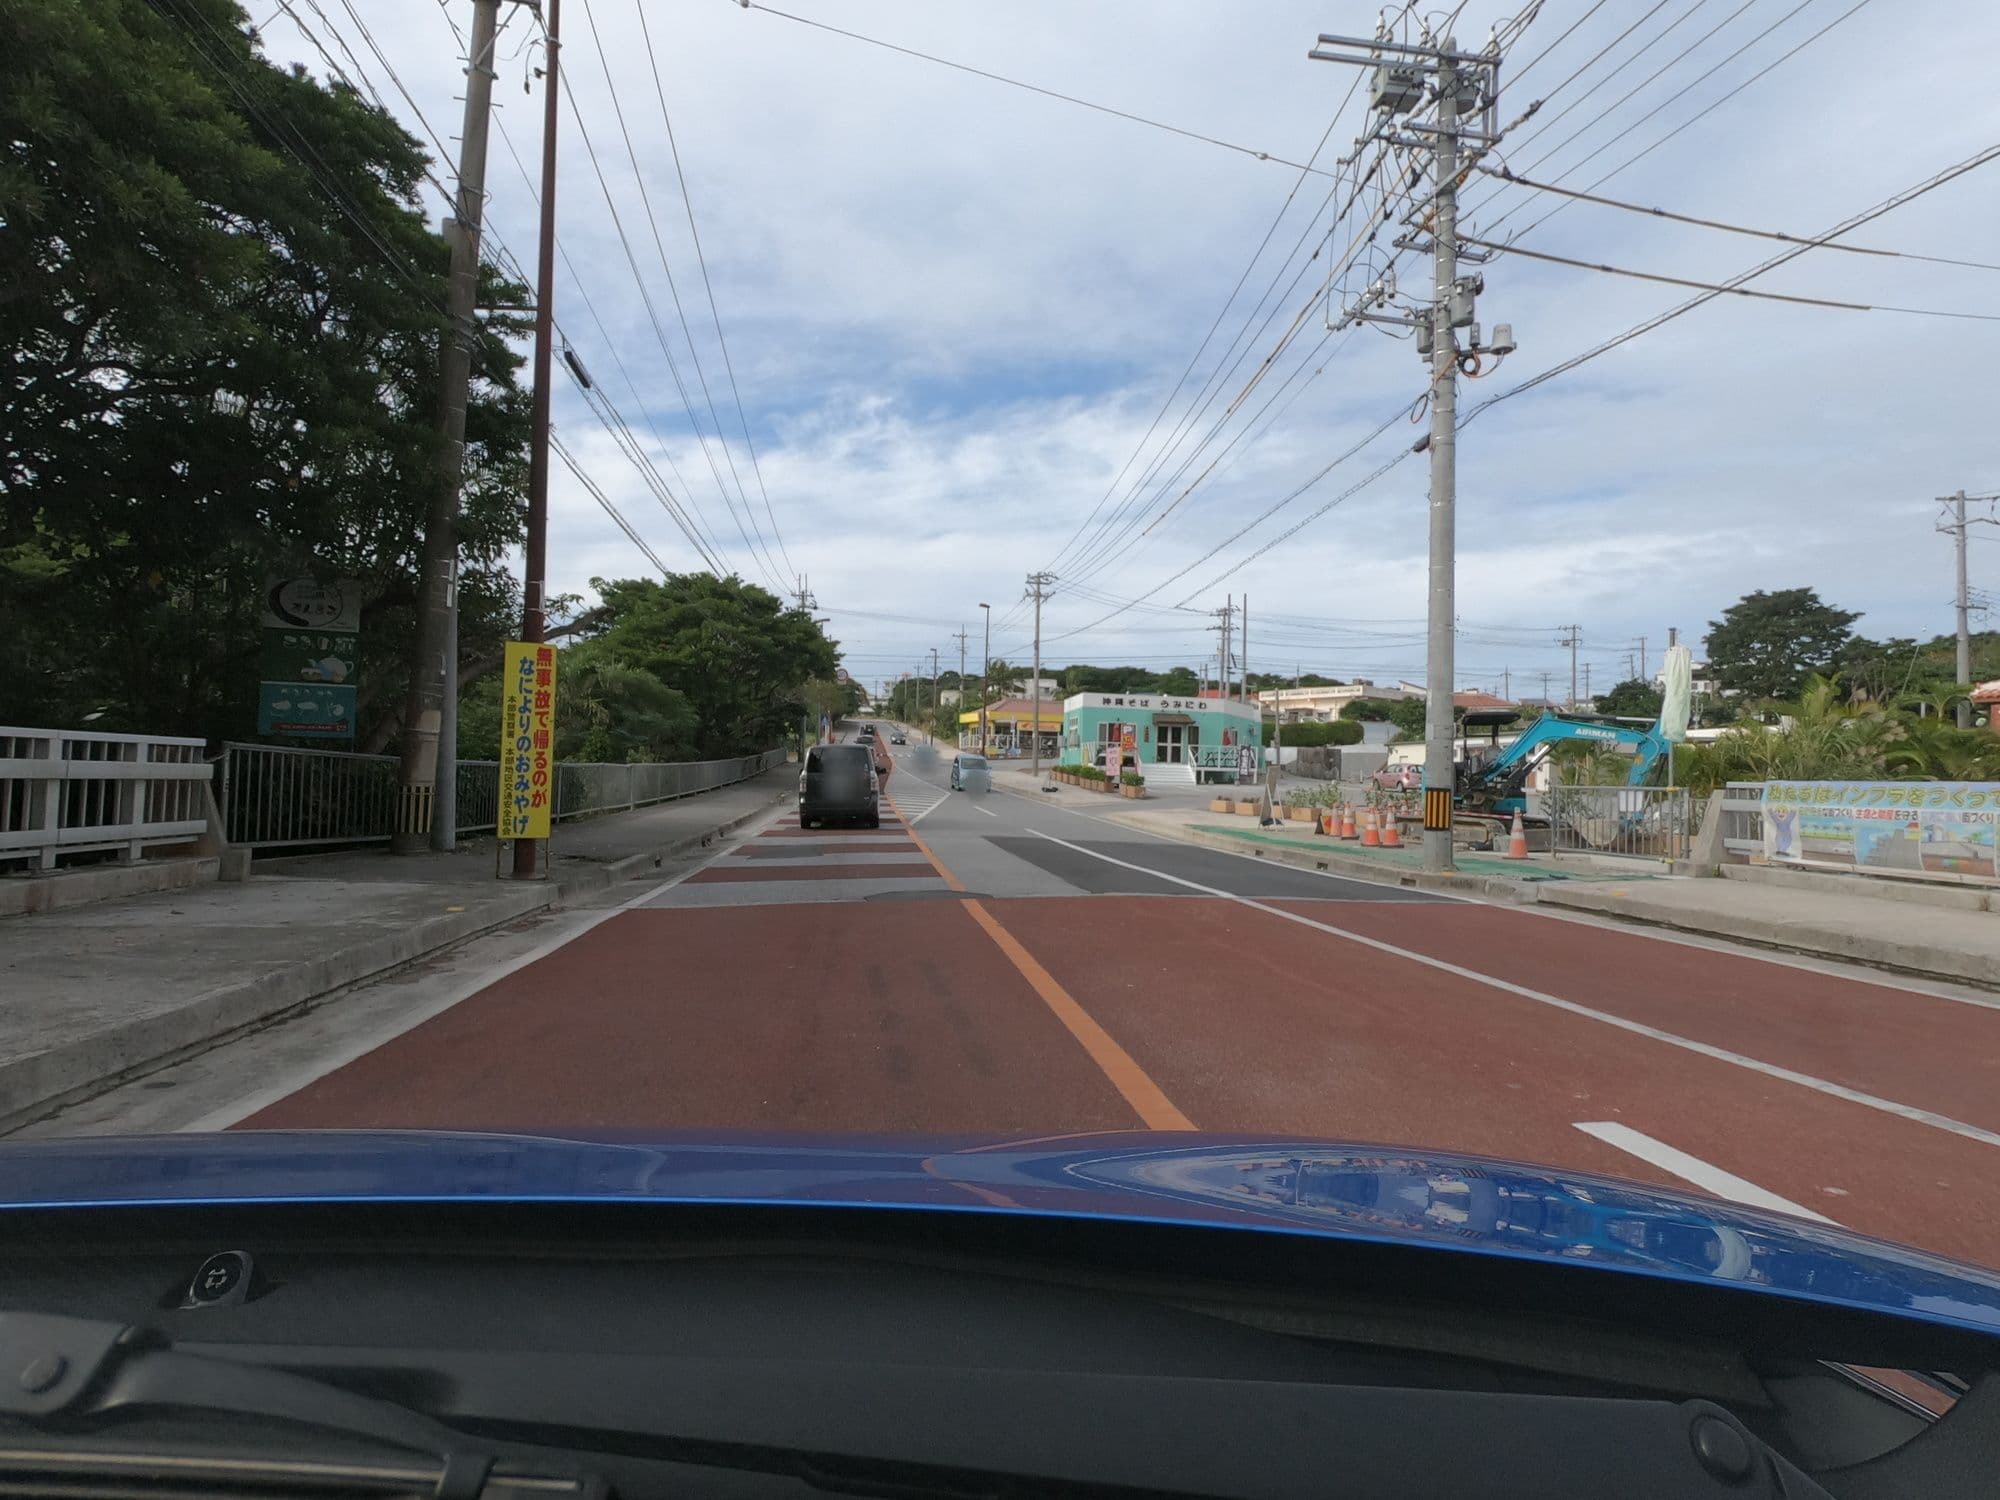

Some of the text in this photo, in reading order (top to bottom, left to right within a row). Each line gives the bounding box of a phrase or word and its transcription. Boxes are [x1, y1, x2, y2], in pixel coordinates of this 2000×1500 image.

[513, 656, 535, 834] なによりのおみやげ
[531, 647, 552, 808] 無事故で帰るのが
[1103, 697, 1150, 707] 沖縄そば
[1574, 728, 1616, 739] AIRMAN
